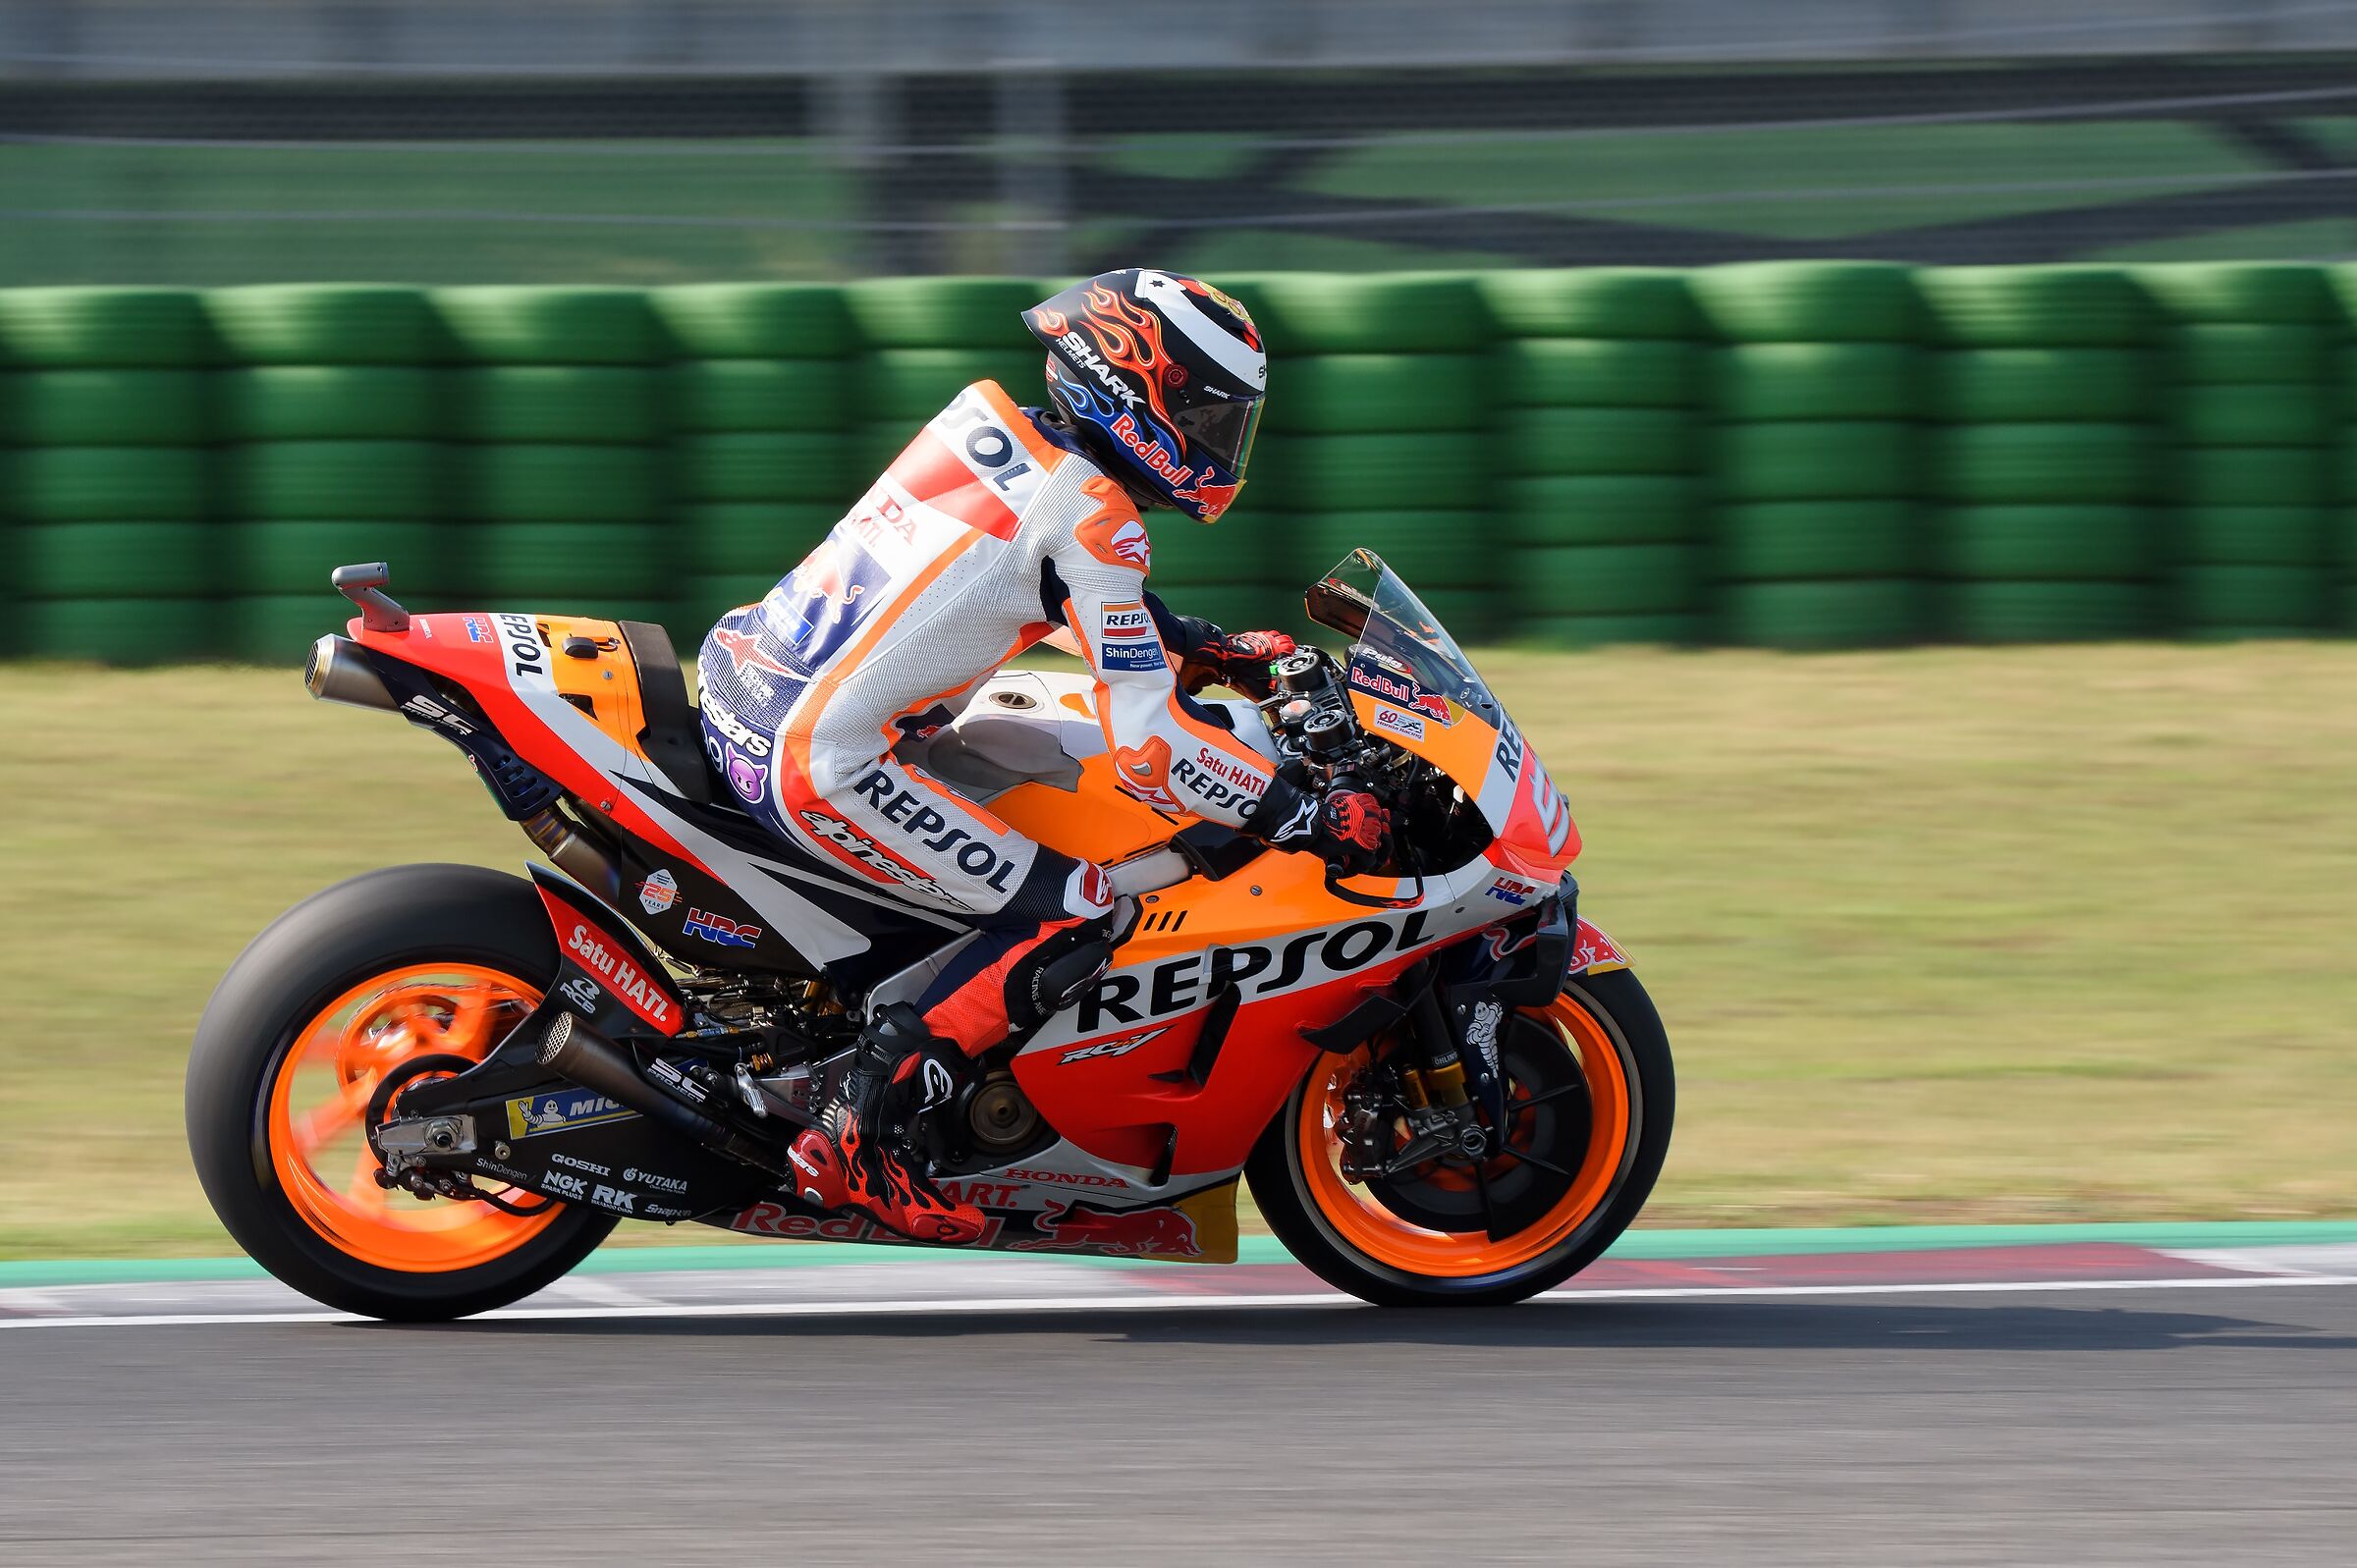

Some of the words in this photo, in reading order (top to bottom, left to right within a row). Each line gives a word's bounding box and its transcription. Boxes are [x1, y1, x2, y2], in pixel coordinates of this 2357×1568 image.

[1055, 338, 1086, 369] HELMETS
[1062, 331, 1145, 409] SHARK
[1203, 385, 1231, 400] SHARK
[1361, 647, 1403, 669] Puig
[1351, 667, 1382, 691] Red
[1381, 677, 1410, 702] Bull
[1378, 710, 1398, 724] 60
[1196, 747, 1229, 777] Satu
[853, 769, 1015, 893] REPSOL
[643, 883, 675, 902] 25
[644, 898, 665, 909] YEARS
[1484, 877, 1537, 905] HRC
[683, 906, 762, 948] HRC
[568, 924, 614, 976] Satu
[613, 961, 668, 1022] HATI.
[1076, 910, 1435, 1034] REPSOL
[560, 983, 596, 1014] RCB
[647, 1067, 703, 1104] PROJECT
[651, 1057, 709, 1100] SC
[476, 1158, 527, 1181] ShinDengen
[551, 1153, 611, 1176] GOSHI
[1004, 1167, 1130, 1189] HONDA
[541, 1183, 561, 1194] SPARK
[562, 1190, 582, 1201] PLUGS
[543, 1169, 587, 1195] NGK
[638, 1171, 687, 1191] YUTAKA
[931, 1179, 1019, 1208] ART.
[592, 1184, 638, 1211] RK
[731, 1201, 868, 1239] Red
